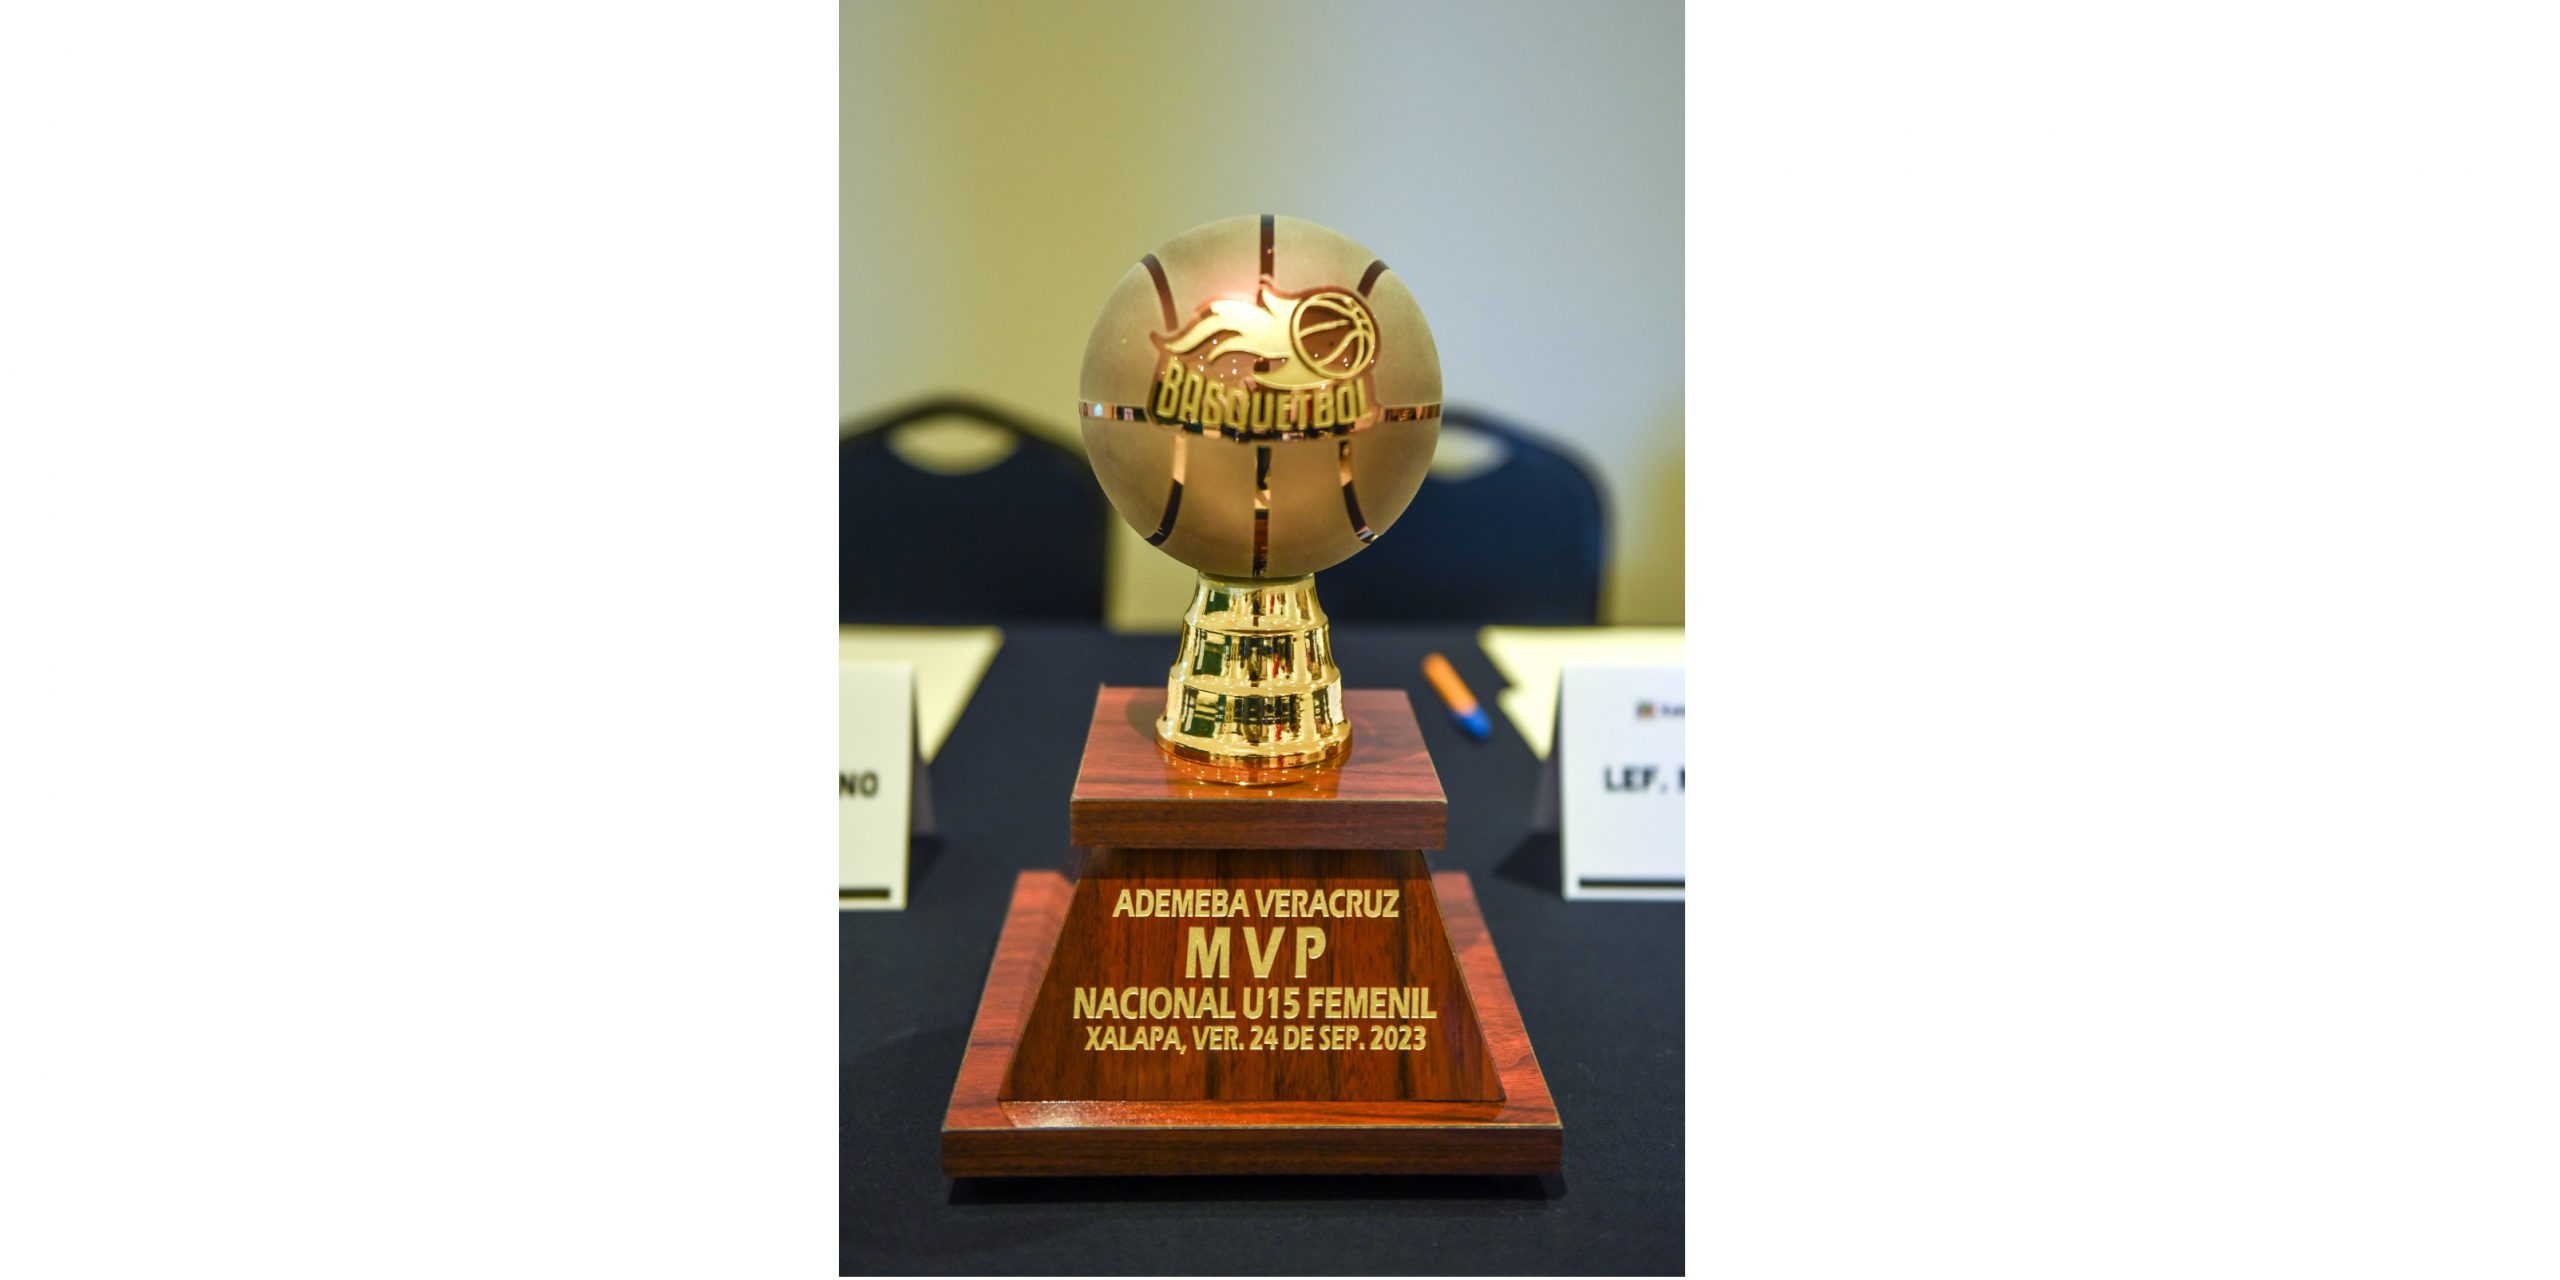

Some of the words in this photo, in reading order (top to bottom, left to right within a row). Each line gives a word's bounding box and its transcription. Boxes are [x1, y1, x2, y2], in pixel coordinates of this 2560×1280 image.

[1156, 356, 1373, 432] BASQUETBOL
[1604, 765, 1668, 792] LEF.
[1112, 889, 1250, 918] ADEMEBA
[1255, 889, 1400, 918] VERACRUZ
[1073, 987, 1236, 1019] NACIONAL
[1243, 987, 1300, 1019] U15
[1307, 987, 1437, 1019] FEMENIL
[1084, 1026, 1187, 1055] XALAPA,
[1192, 1026, 1245, 1051] VER.
[1250, 1026, 1279, 1051] 24
[1283, 1026, 1315, 1051] DE
[1319, 1026, 1365, 1051] SEP.
[1370, 1026, 1427, 1051] 2023
